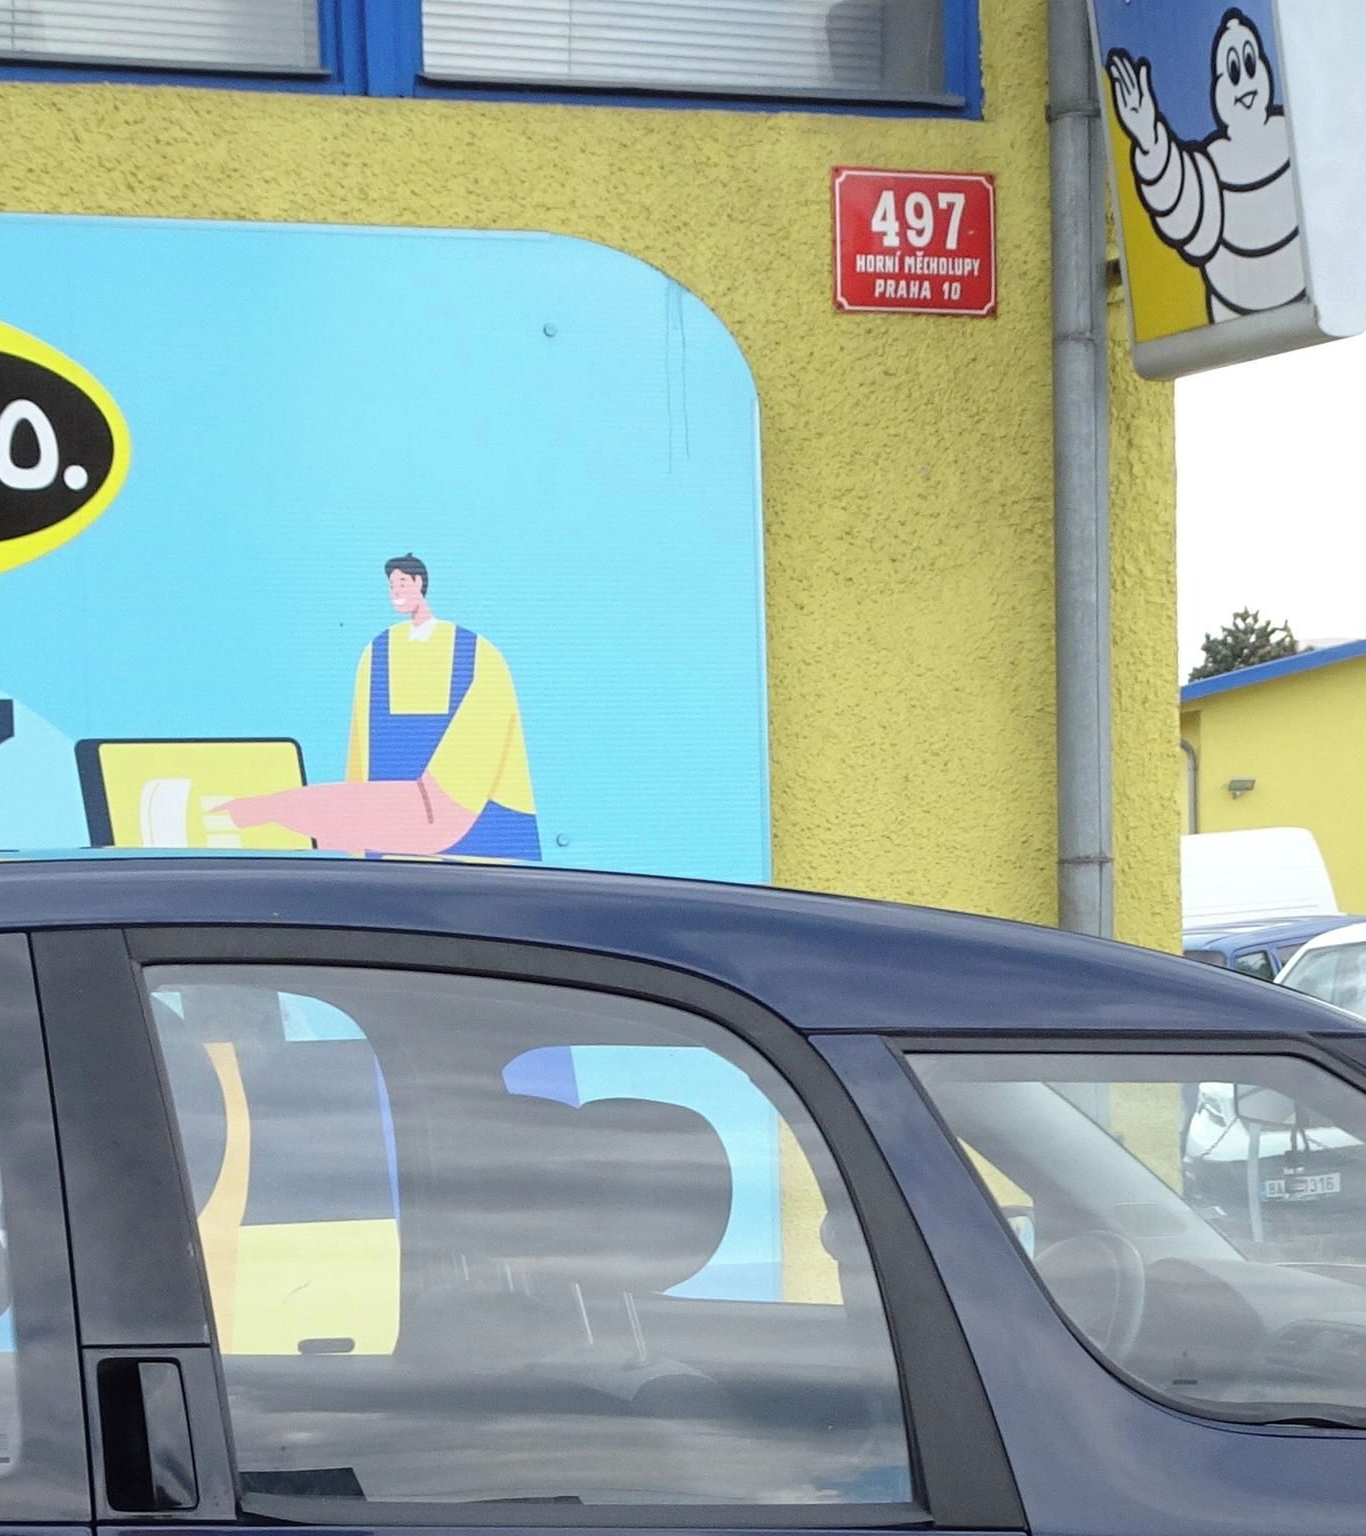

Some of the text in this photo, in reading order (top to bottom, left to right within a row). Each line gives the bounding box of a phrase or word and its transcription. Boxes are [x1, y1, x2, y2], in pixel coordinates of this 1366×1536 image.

[871, 189, 966, 250] 497
[855, 250, 981, 277] HORNÍ MĚCHOLUPY
[874, 278, 962, 301] PRAHA 10
